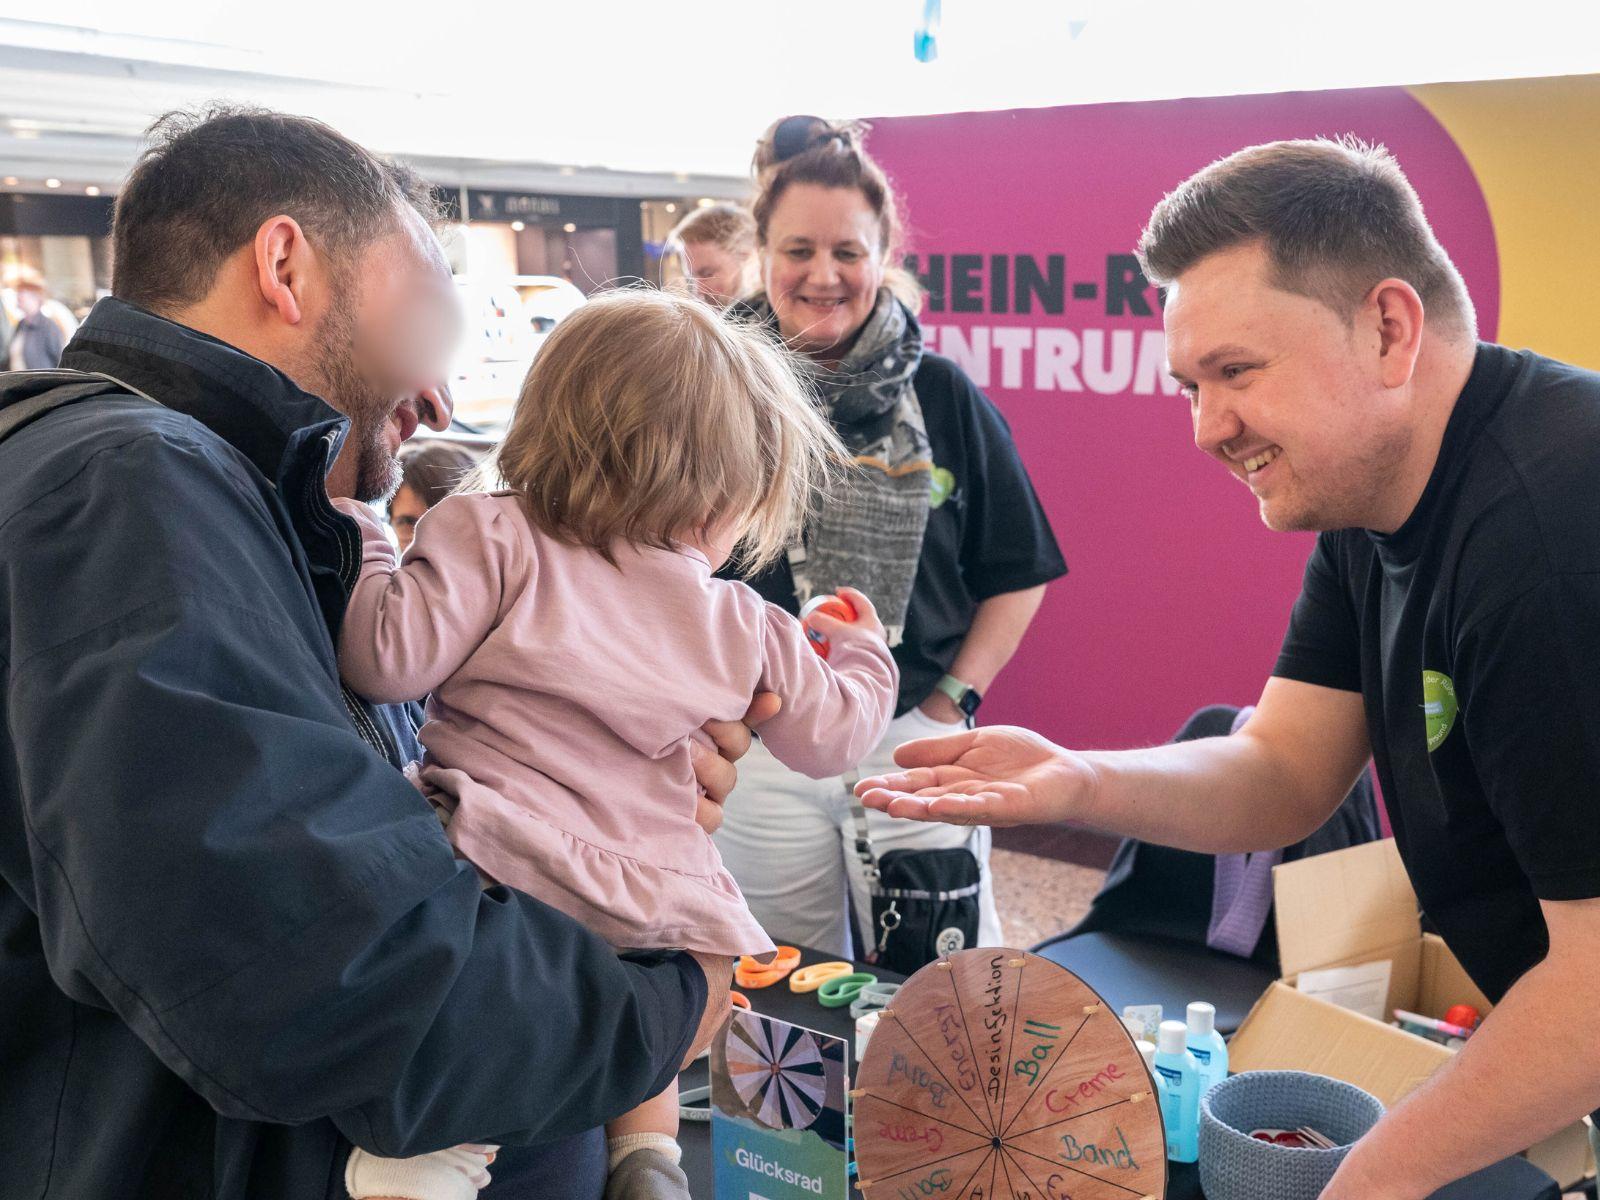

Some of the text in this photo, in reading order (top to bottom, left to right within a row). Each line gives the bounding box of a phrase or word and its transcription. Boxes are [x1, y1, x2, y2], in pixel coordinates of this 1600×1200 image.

[886, 1046, 952, 1109] Band
[1013, 1019, 1062, 1087] Ball
[1045, 1063, 1126, 1113] Creme
[735, 1147, 823, 1195] Glücksrad
[1057, 1126, 1141, 1171] Band
